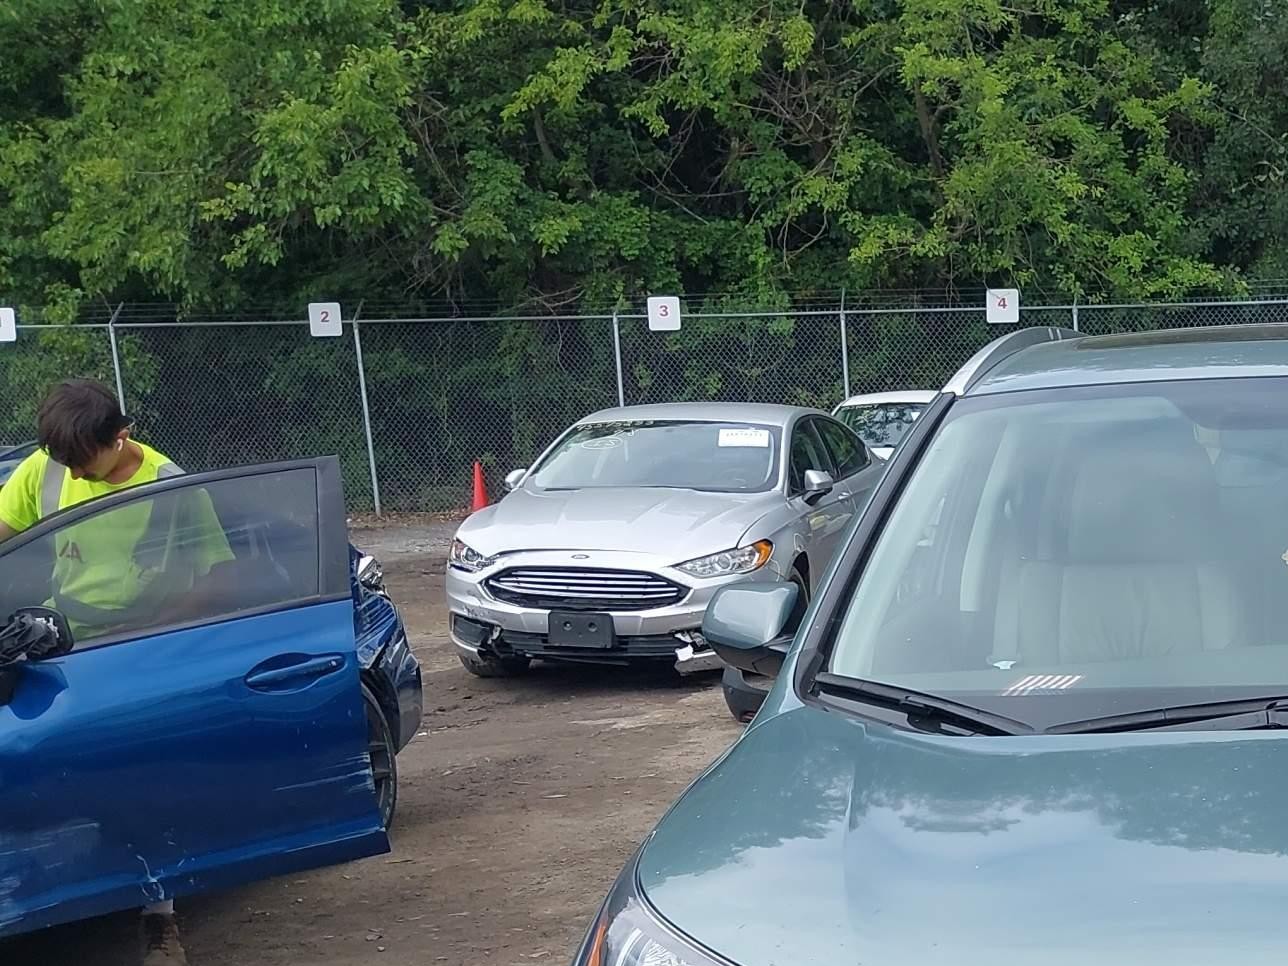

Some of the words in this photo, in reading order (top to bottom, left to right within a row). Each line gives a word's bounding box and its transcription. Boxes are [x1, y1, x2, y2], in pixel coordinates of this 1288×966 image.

[997, 297, 1007, 309] 4
[320, 311, 330, 323] 2
[659, 305, 669, 317] 3
